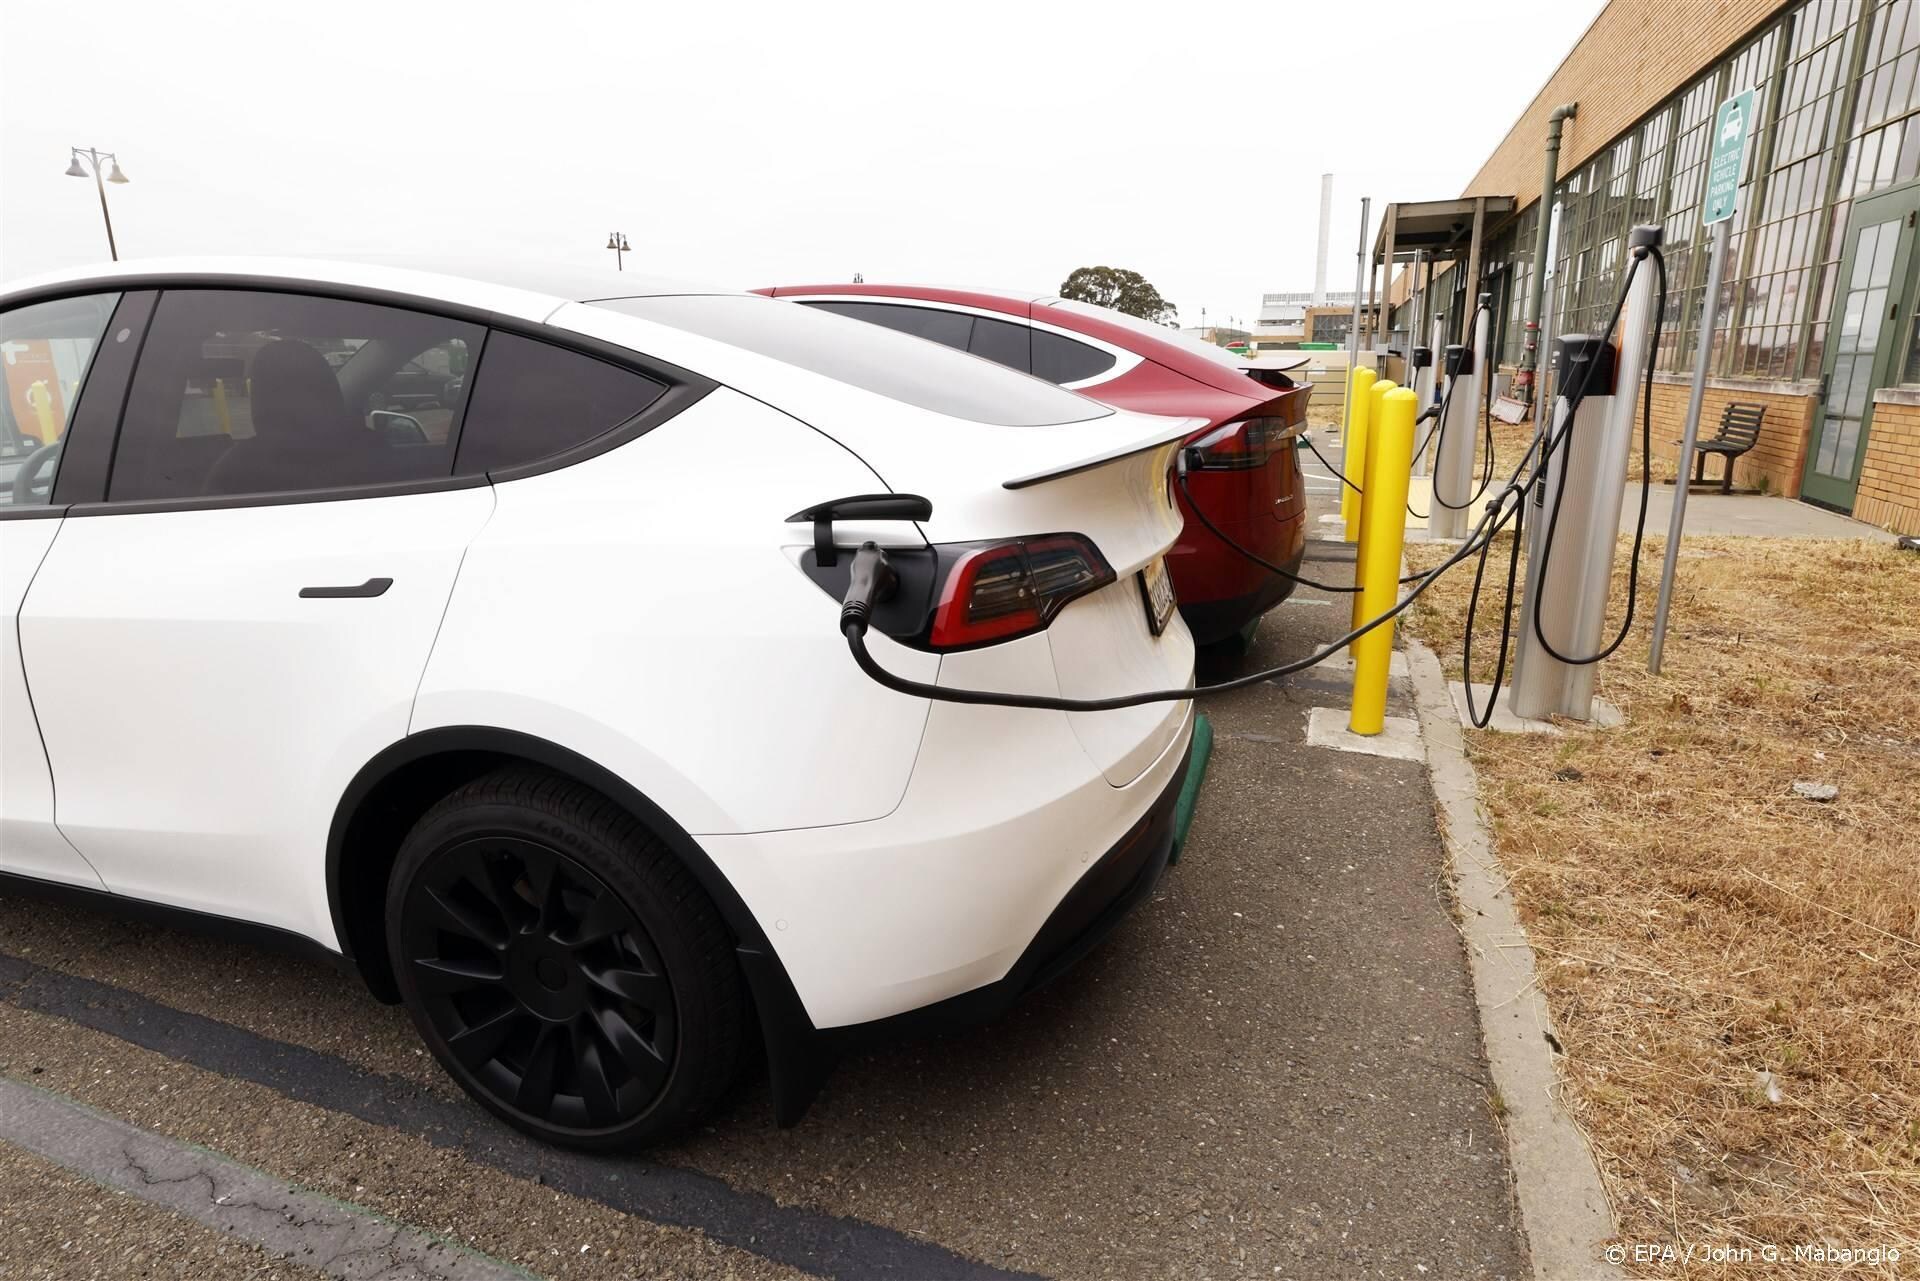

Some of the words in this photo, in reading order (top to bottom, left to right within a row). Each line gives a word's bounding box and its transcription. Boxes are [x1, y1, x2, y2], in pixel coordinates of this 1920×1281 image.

[1713, 147, 1741, 169] ELECTRIC
[1713, 163, 1737, 182] VEHICLE
[1710, 179, 1735, 198] PARKING
[1712, 195, 1728, 211] ONLY
